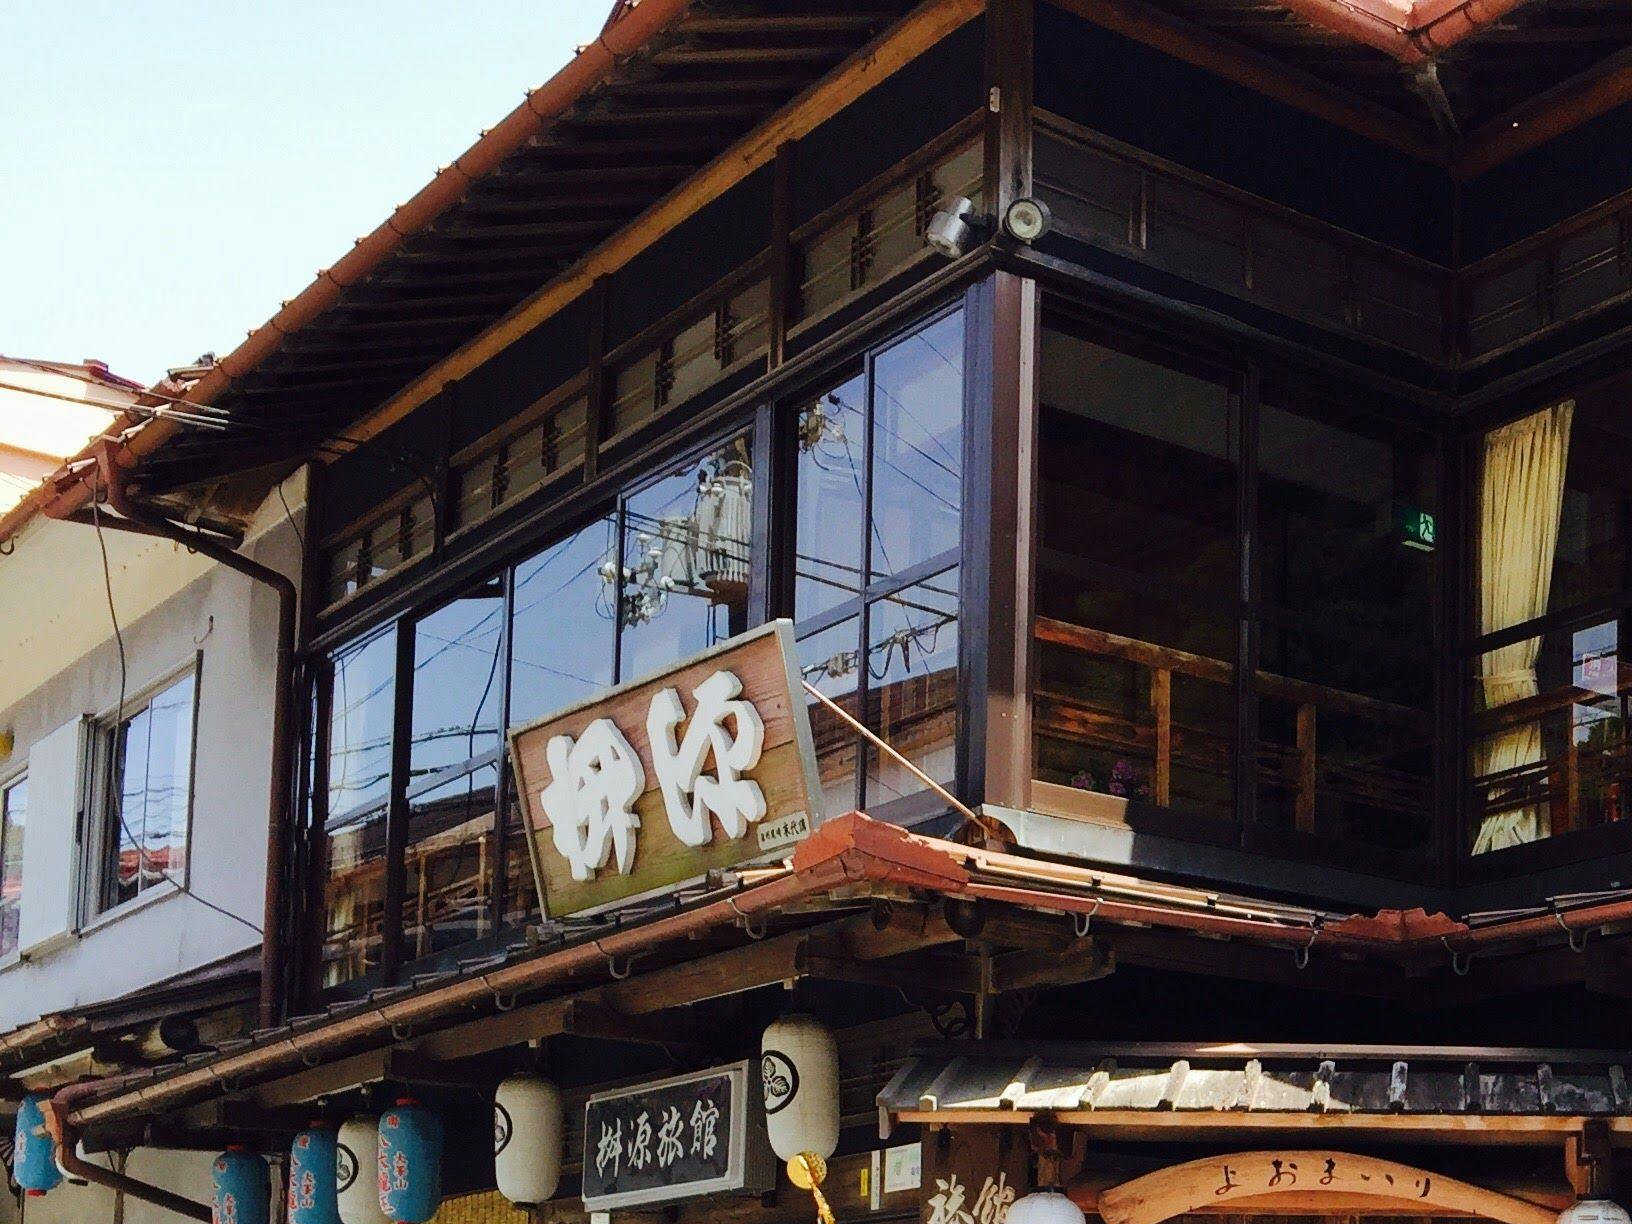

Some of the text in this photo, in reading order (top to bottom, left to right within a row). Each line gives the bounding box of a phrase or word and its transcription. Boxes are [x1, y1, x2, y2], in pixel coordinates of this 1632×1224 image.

[1215, 1158, 1431, 1197] よおまいり
